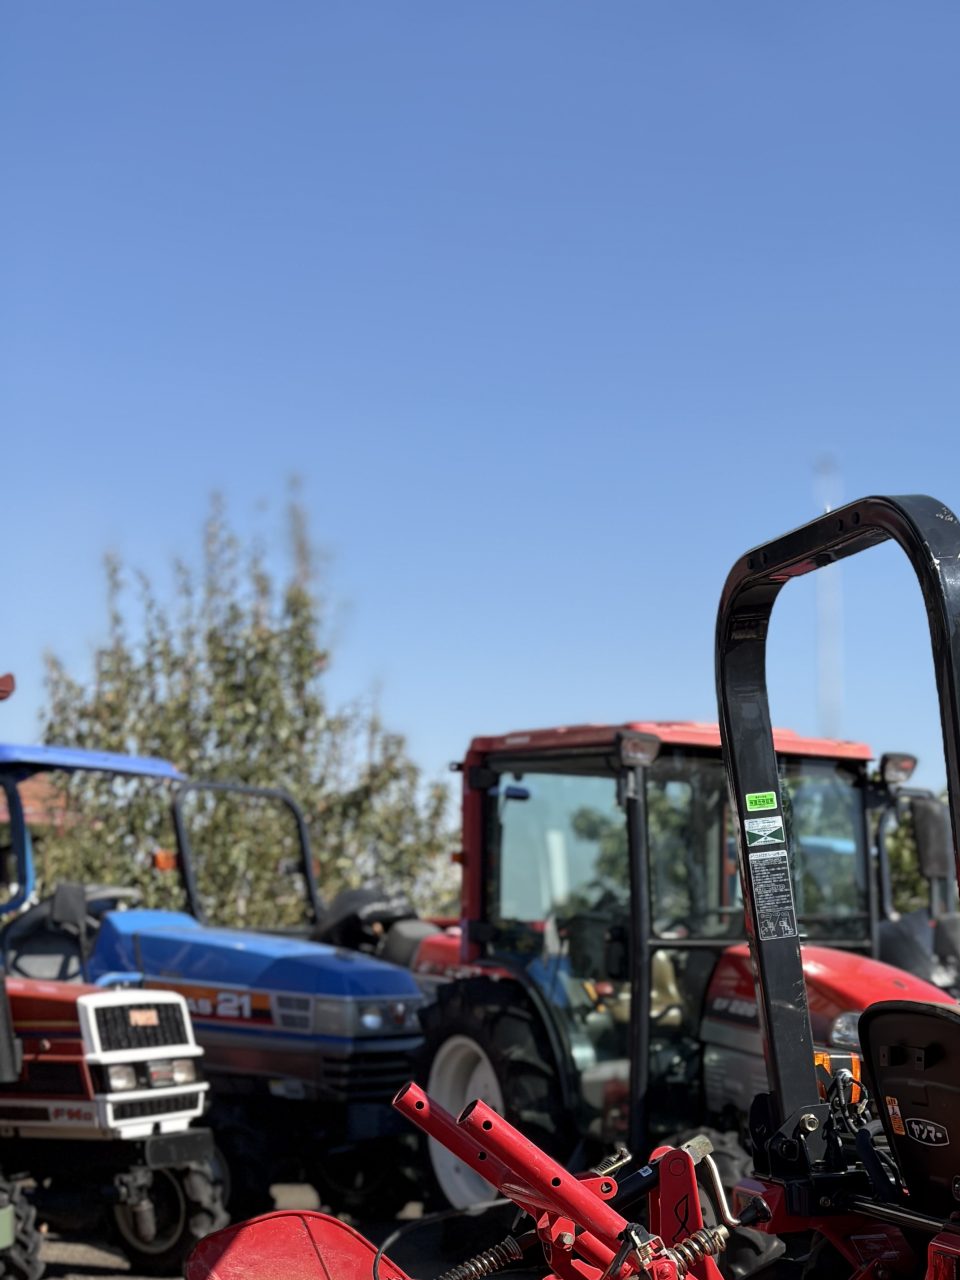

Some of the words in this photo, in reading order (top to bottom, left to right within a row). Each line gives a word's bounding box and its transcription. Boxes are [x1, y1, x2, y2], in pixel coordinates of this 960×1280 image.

[217, 992, 251, 1018] 21
[911, 1121, 943, 1142] ヤンマー
